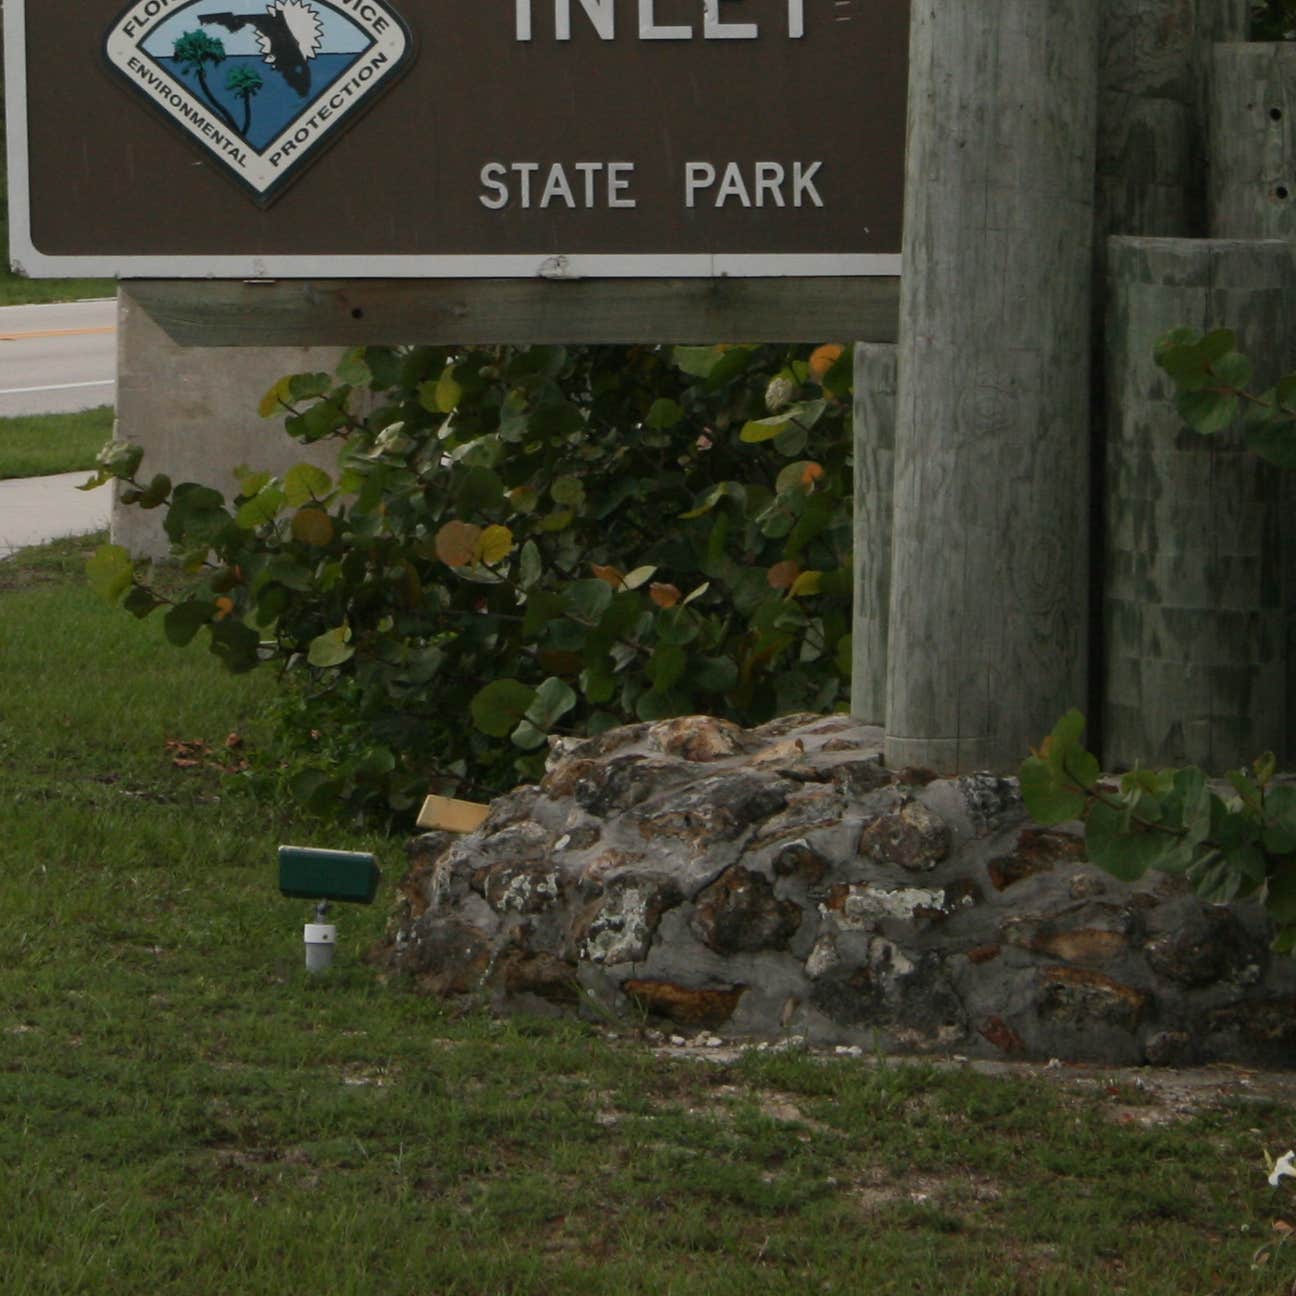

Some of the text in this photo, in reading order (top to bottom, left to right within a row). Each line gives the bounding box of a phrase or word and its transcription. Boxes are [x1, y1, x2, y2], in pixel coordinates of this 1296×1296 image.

[126, 53, 388, 168] ENVIRONMENTAL PROTECTION
[479, 161, 824, 209] STATE PARK
